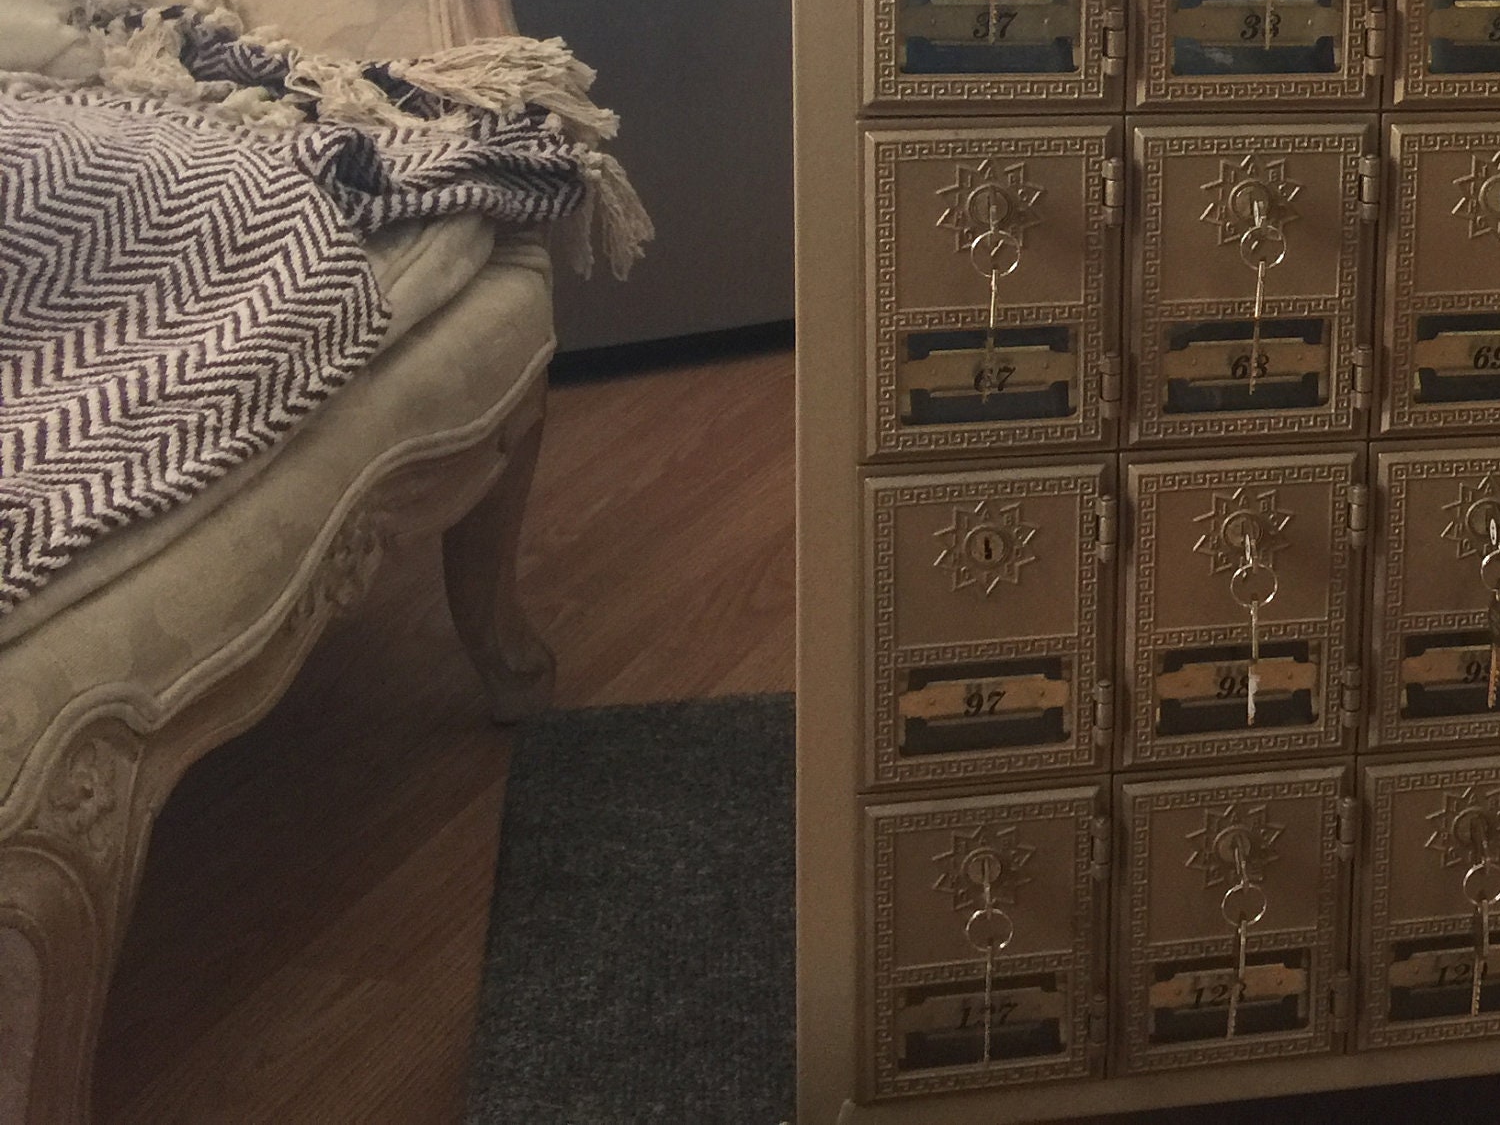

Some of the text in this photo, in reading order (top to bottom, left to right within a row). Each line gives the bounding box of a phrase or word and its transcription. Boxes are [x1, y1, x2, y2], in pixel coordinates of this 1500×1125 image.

[973, 12, 1017, 40] 37
[1463, 661, 1492, 684] 9
[962, 690, 1007, 717] 97
